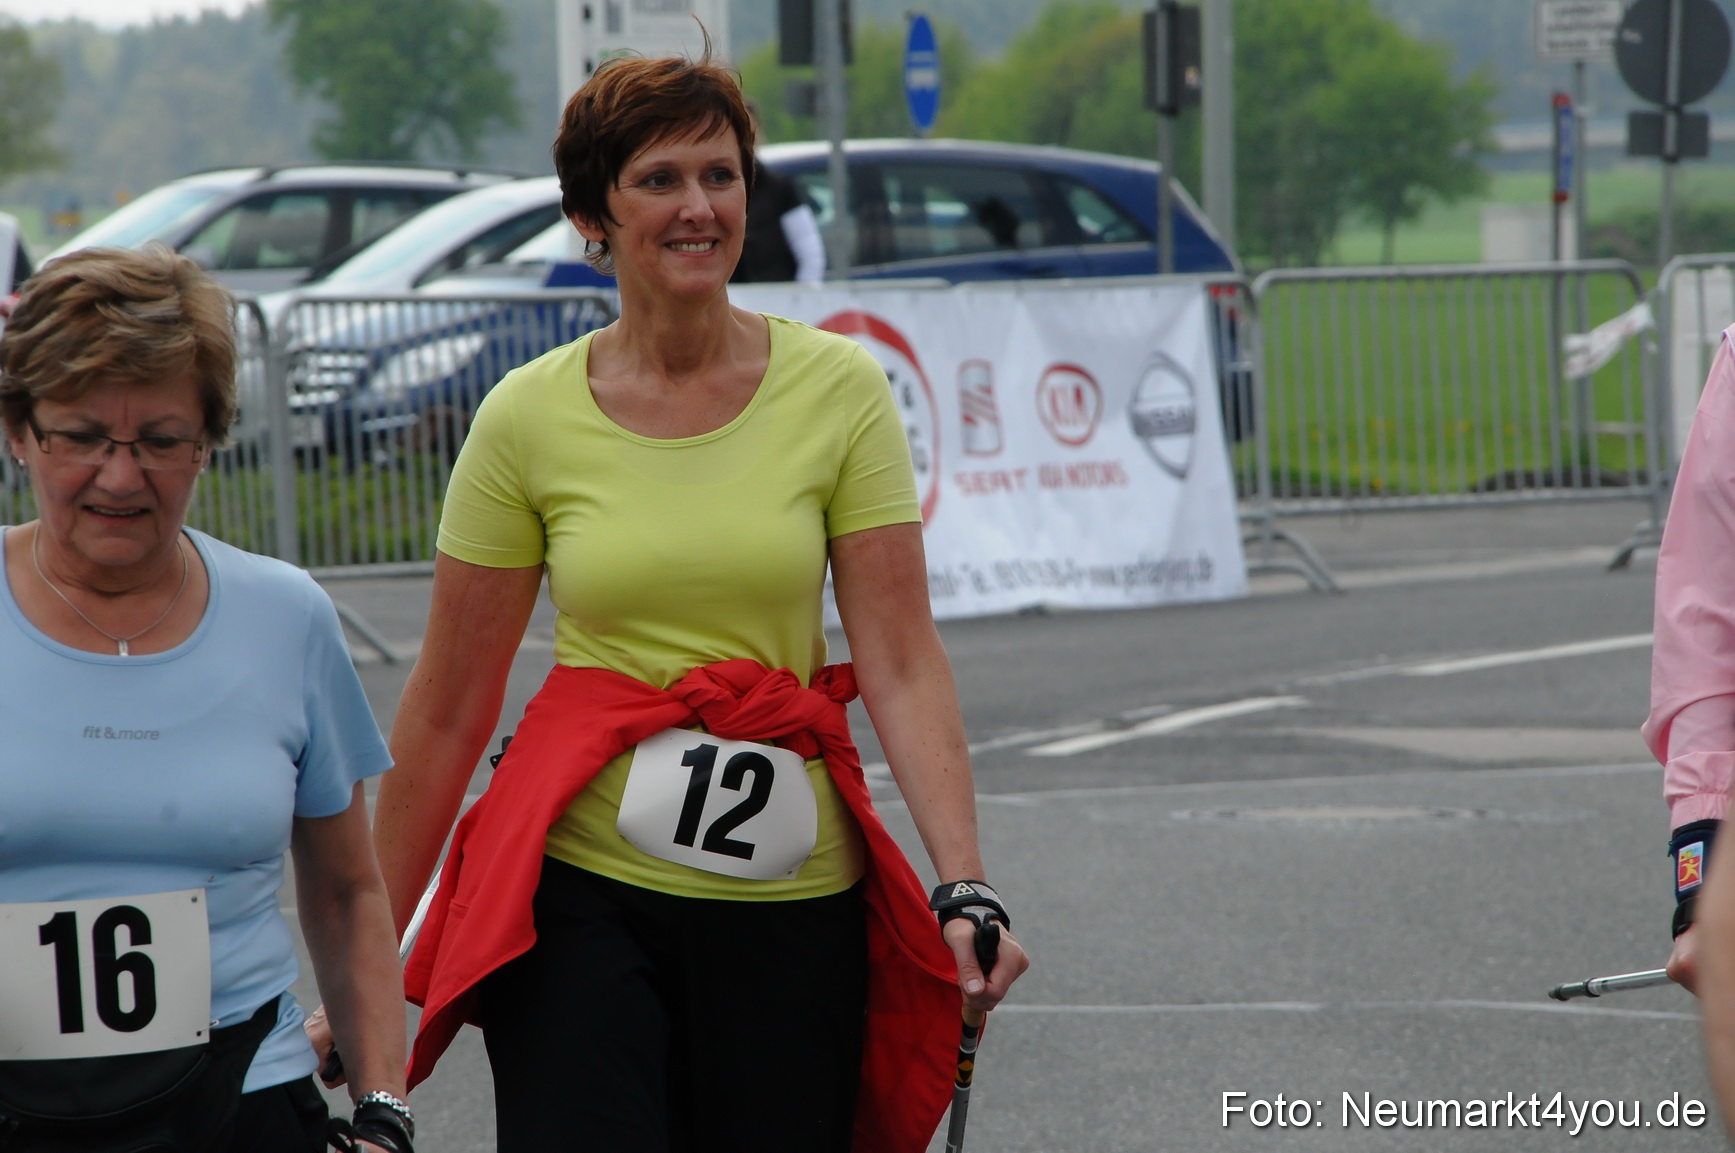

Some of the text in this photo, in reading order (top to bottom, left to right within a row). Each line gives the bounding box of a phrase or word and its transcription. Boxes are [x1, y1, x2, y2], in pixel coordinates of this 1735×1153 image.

[954, 468, 1029, 497] SEAT
[673, 743, 775, 861] 12
[38, 904, 157, 1035] 16
